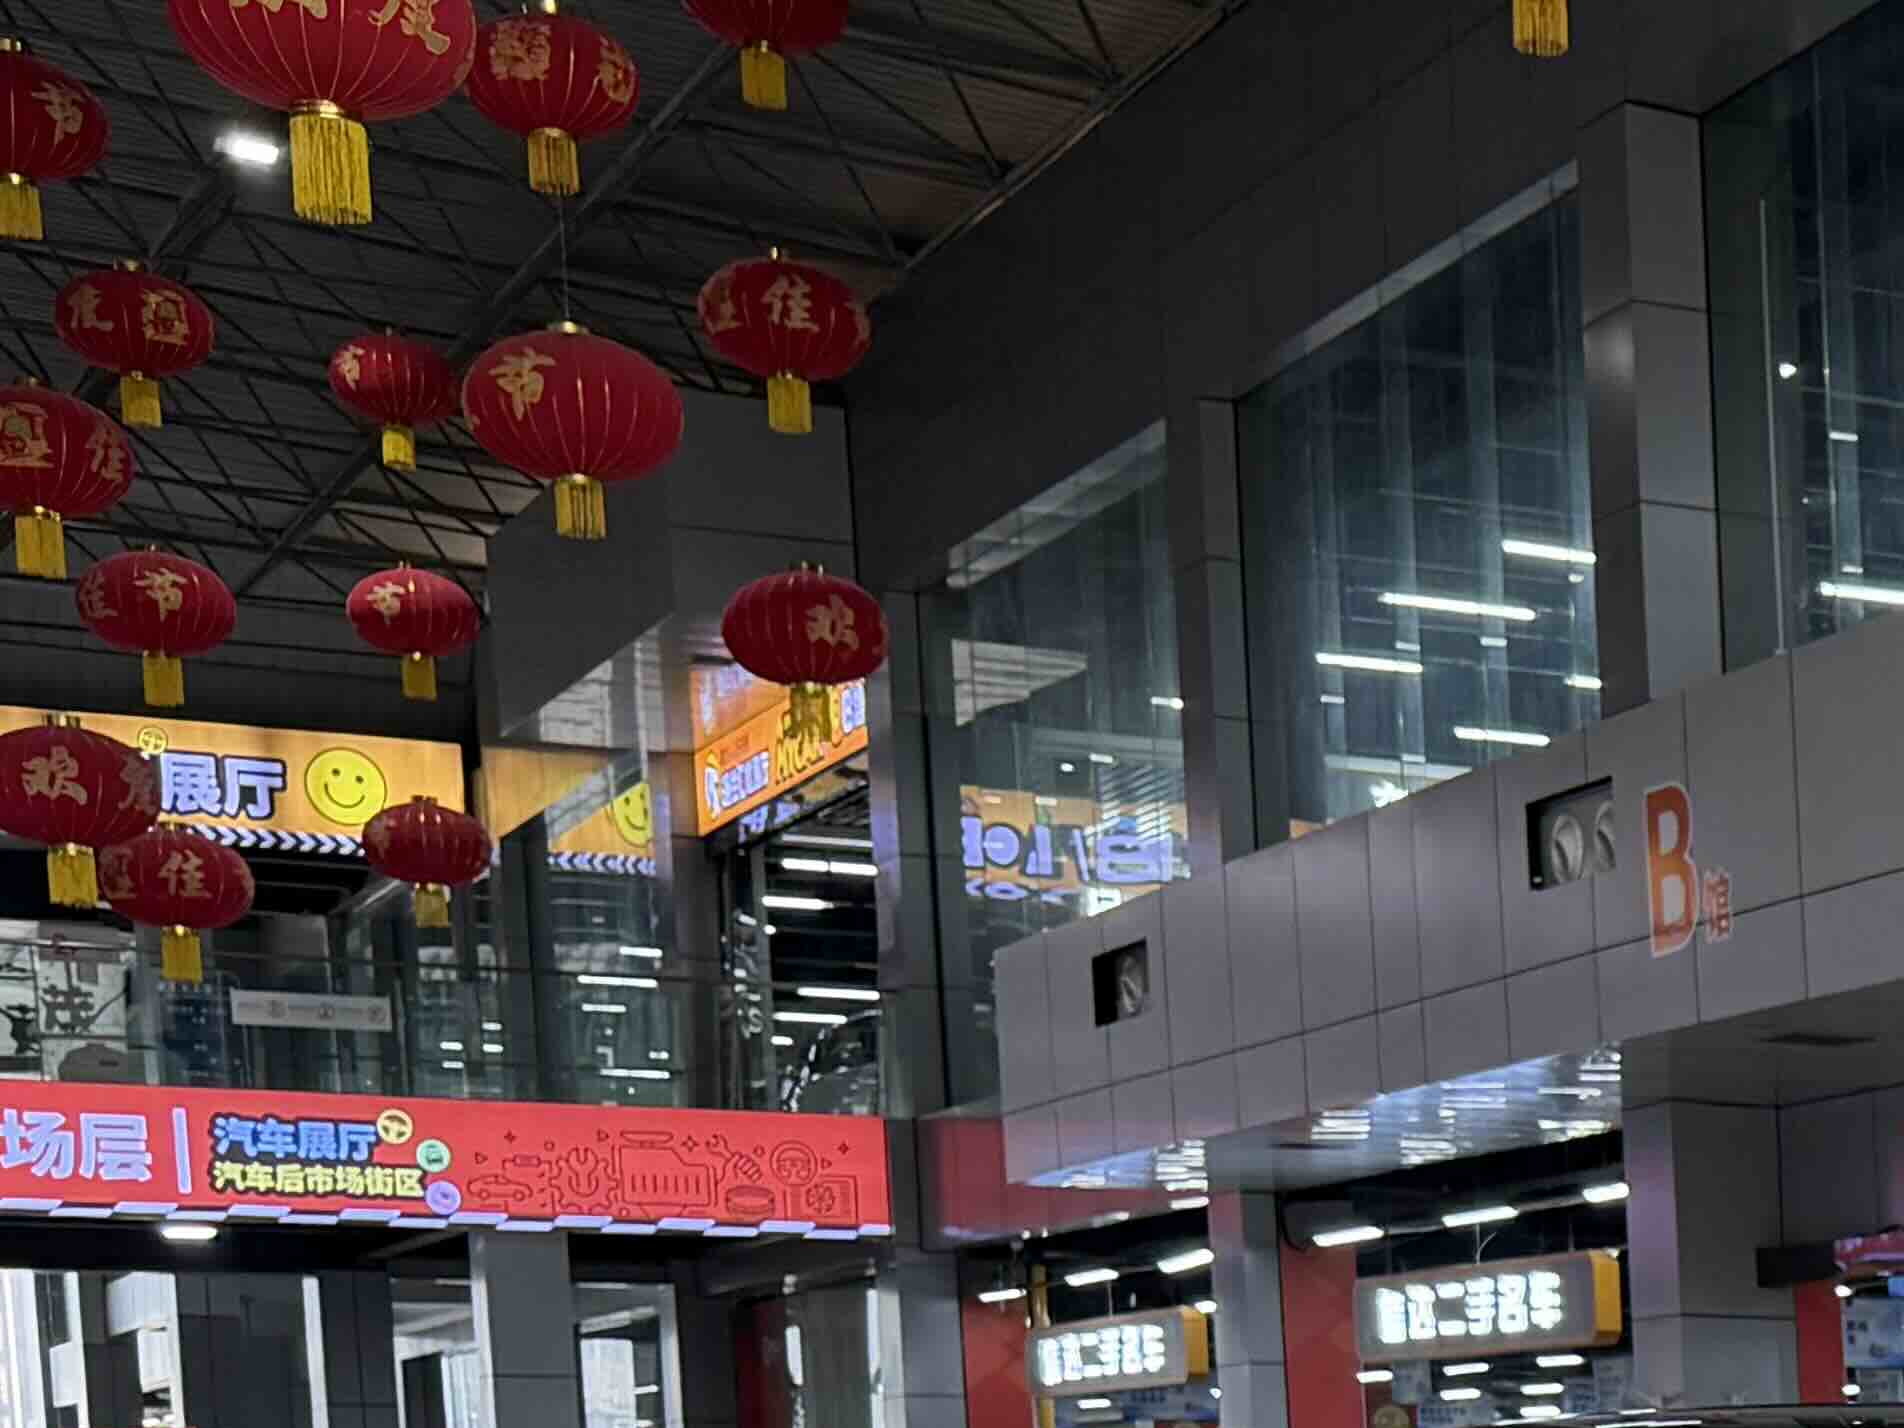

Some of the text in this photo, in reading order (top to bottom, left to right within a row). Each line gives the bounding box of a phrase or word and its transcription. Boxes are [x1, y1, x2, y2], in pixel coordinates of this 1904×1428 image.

[158, 753, 287, 820] 展厅
[213, 1116, 378, 1161] 汽车展厅
[213, 1163, 425, 1198] 汽车后市场街区
